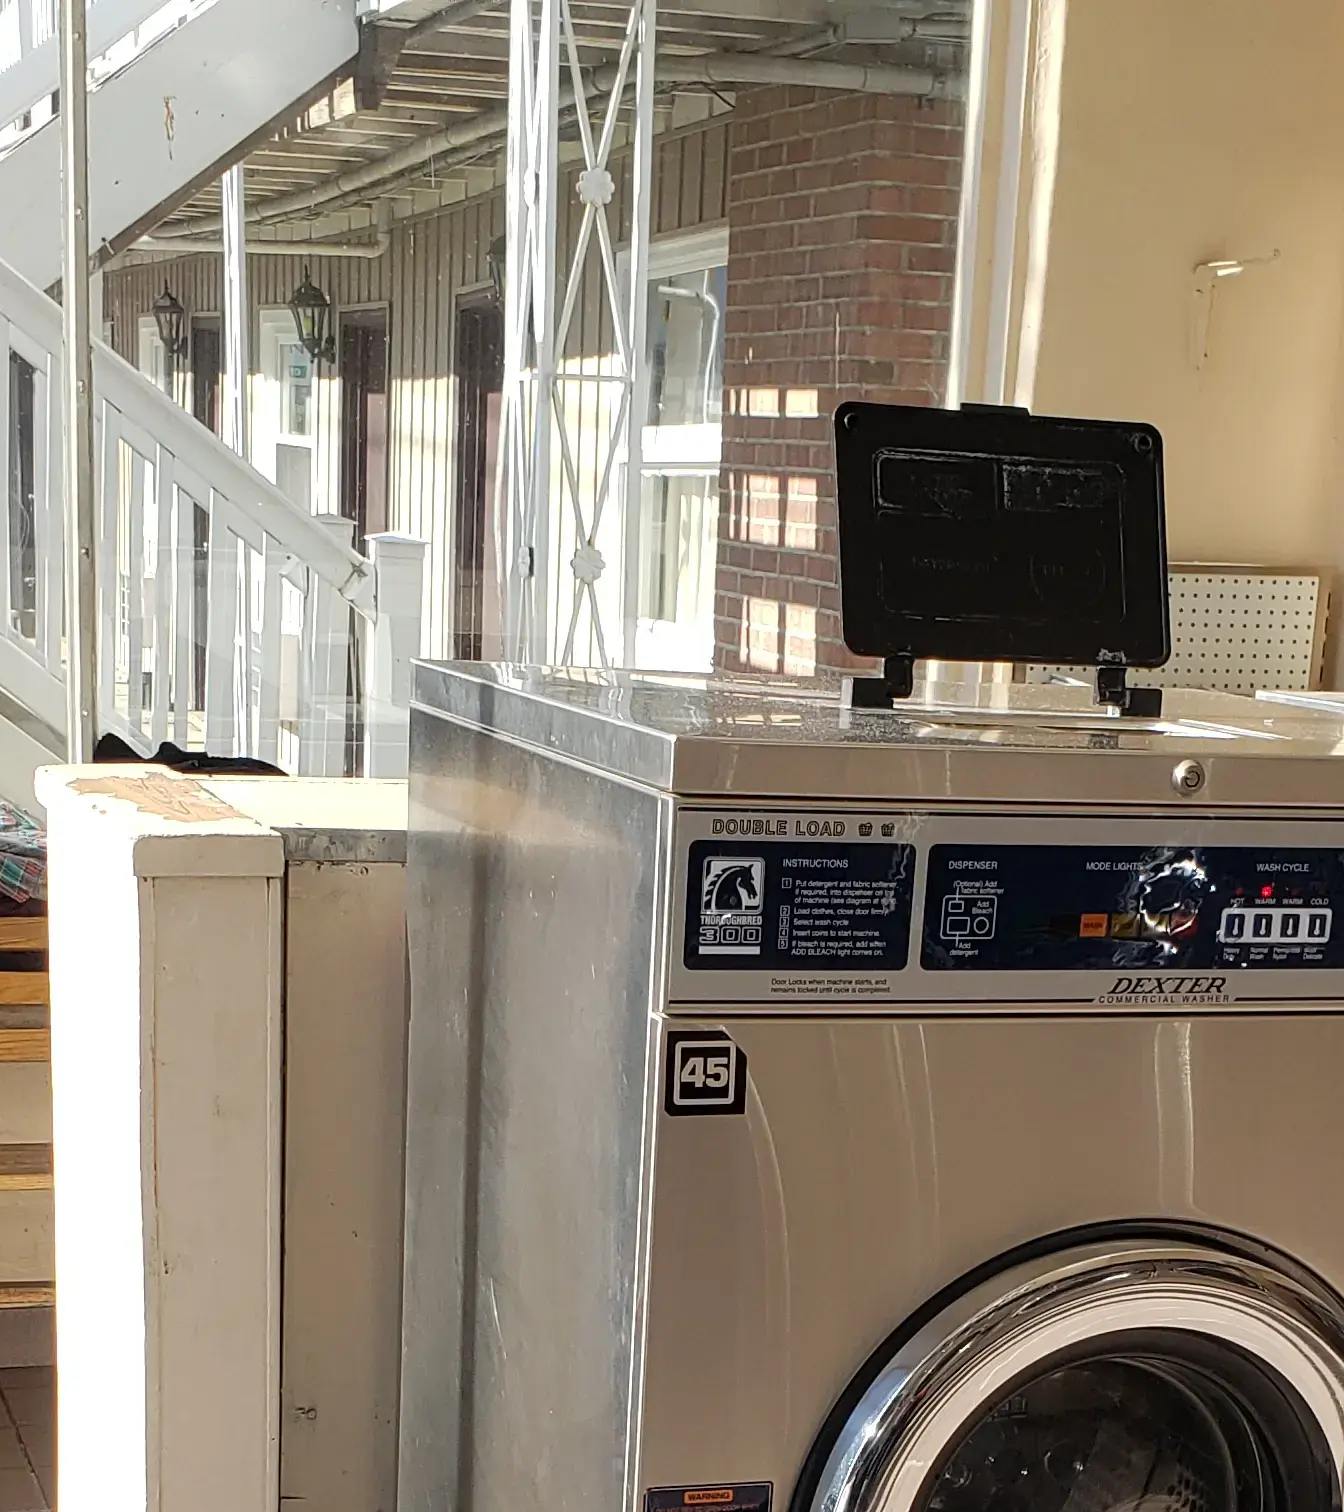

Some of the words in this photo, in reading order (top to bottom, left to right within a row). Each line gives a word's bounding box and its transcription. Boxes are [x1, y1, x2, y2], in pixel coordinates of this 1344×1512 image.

[712, 818, 788, 836] DOUBLE
[795, 820, 846, 837] LOAD
[782, 859, 849, 869] INSTRUCTIONS
[948, 860, 998, 870] DISPENSER
[1085, 862, 1111, 871] MODE
[1113, 862, 1144, 871] LIGHTS
[1256, 863, 1281, 872] WASH
[1282, 863, 1310, 872] CYCLE
[796, 880, 807, 888] Put
[807, 880, 838, 889] detergent
[839, 880, 852, 888] and
[853, 880, 870, 888] fabric
[984, 880, 998, 888] Add
[971, 907, 993, 915] Bleach
[700, 915, 763, 926] THOROUGHBRED
[699, 926, 762, 944] 300
[807, 948, 836, 956] BLEACH
[837, 949, 850, 957] light
[1107, 976, 1227, 994] DEXTER
[797, 986, 818, 994] locked
[1098, 995, 1176, 1004] COMMERCIAL
[1181, 994, 1230, 1003] WASHER
[680, 1056, 730, 1089] 45
[688, 1492, 730, 1501] WARNING
